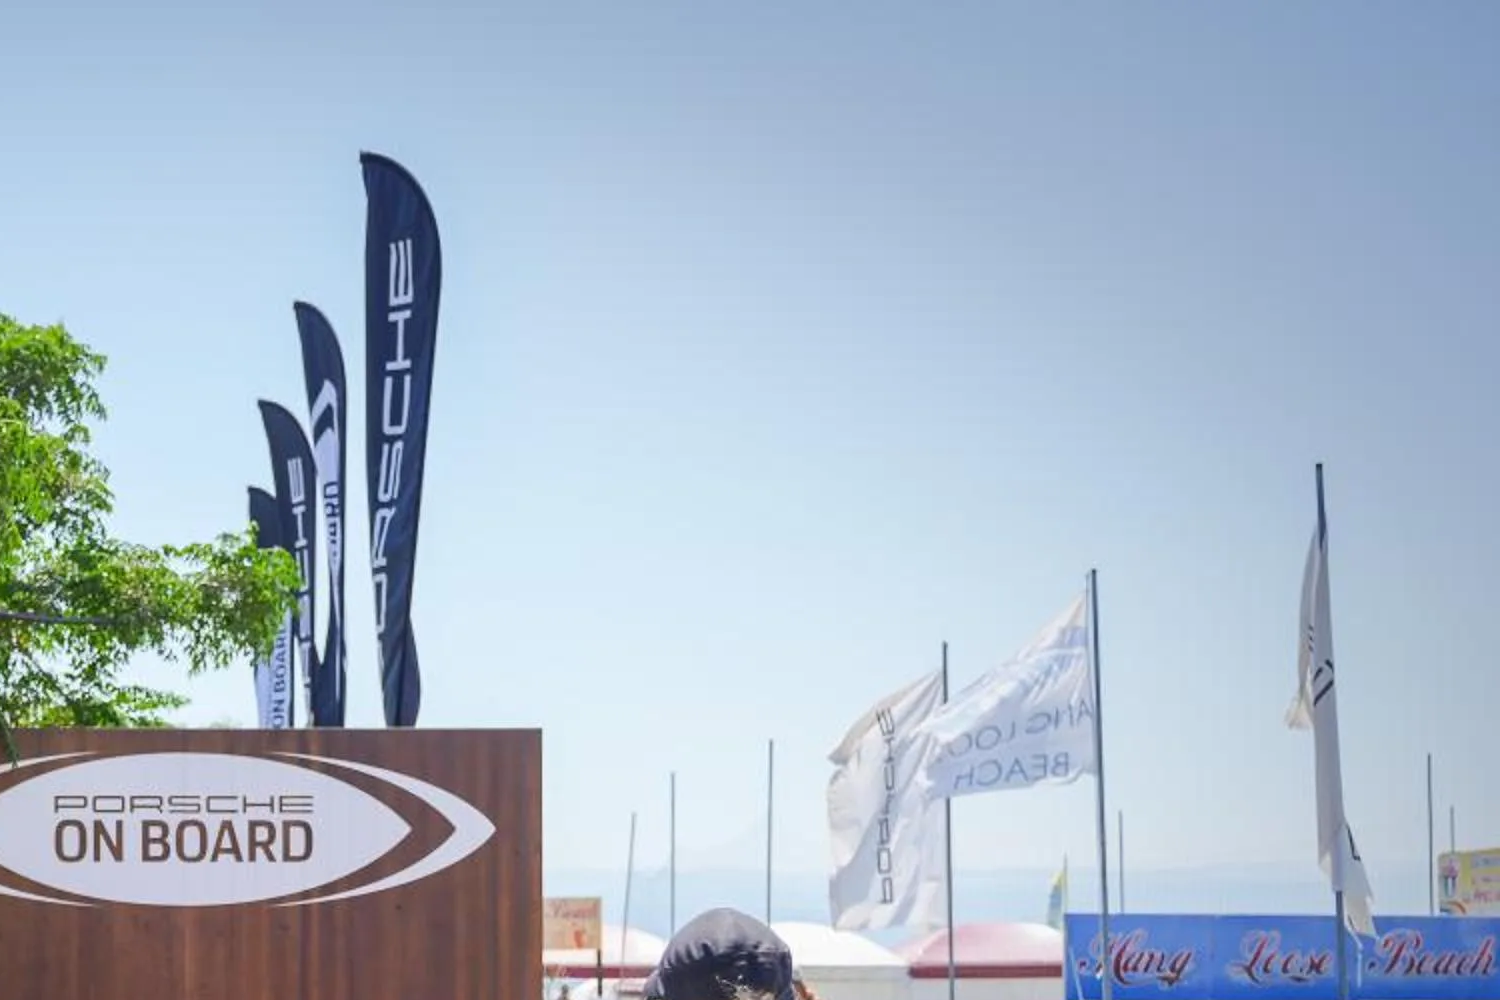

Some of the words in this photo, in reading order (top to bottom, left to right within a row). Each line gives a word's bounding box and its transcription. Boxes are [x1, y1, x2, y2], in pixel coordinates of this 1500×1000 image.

[371, 238, 414, 674] ORSCHE
[53, 794, 315, 814] PORSCHE
[53, 818, 125, 864] ON
[140, 818, 315, 864] BOARD
[1227, 929, 1332, 985] Loose
[1369, 928, 1496, 978] Beach
